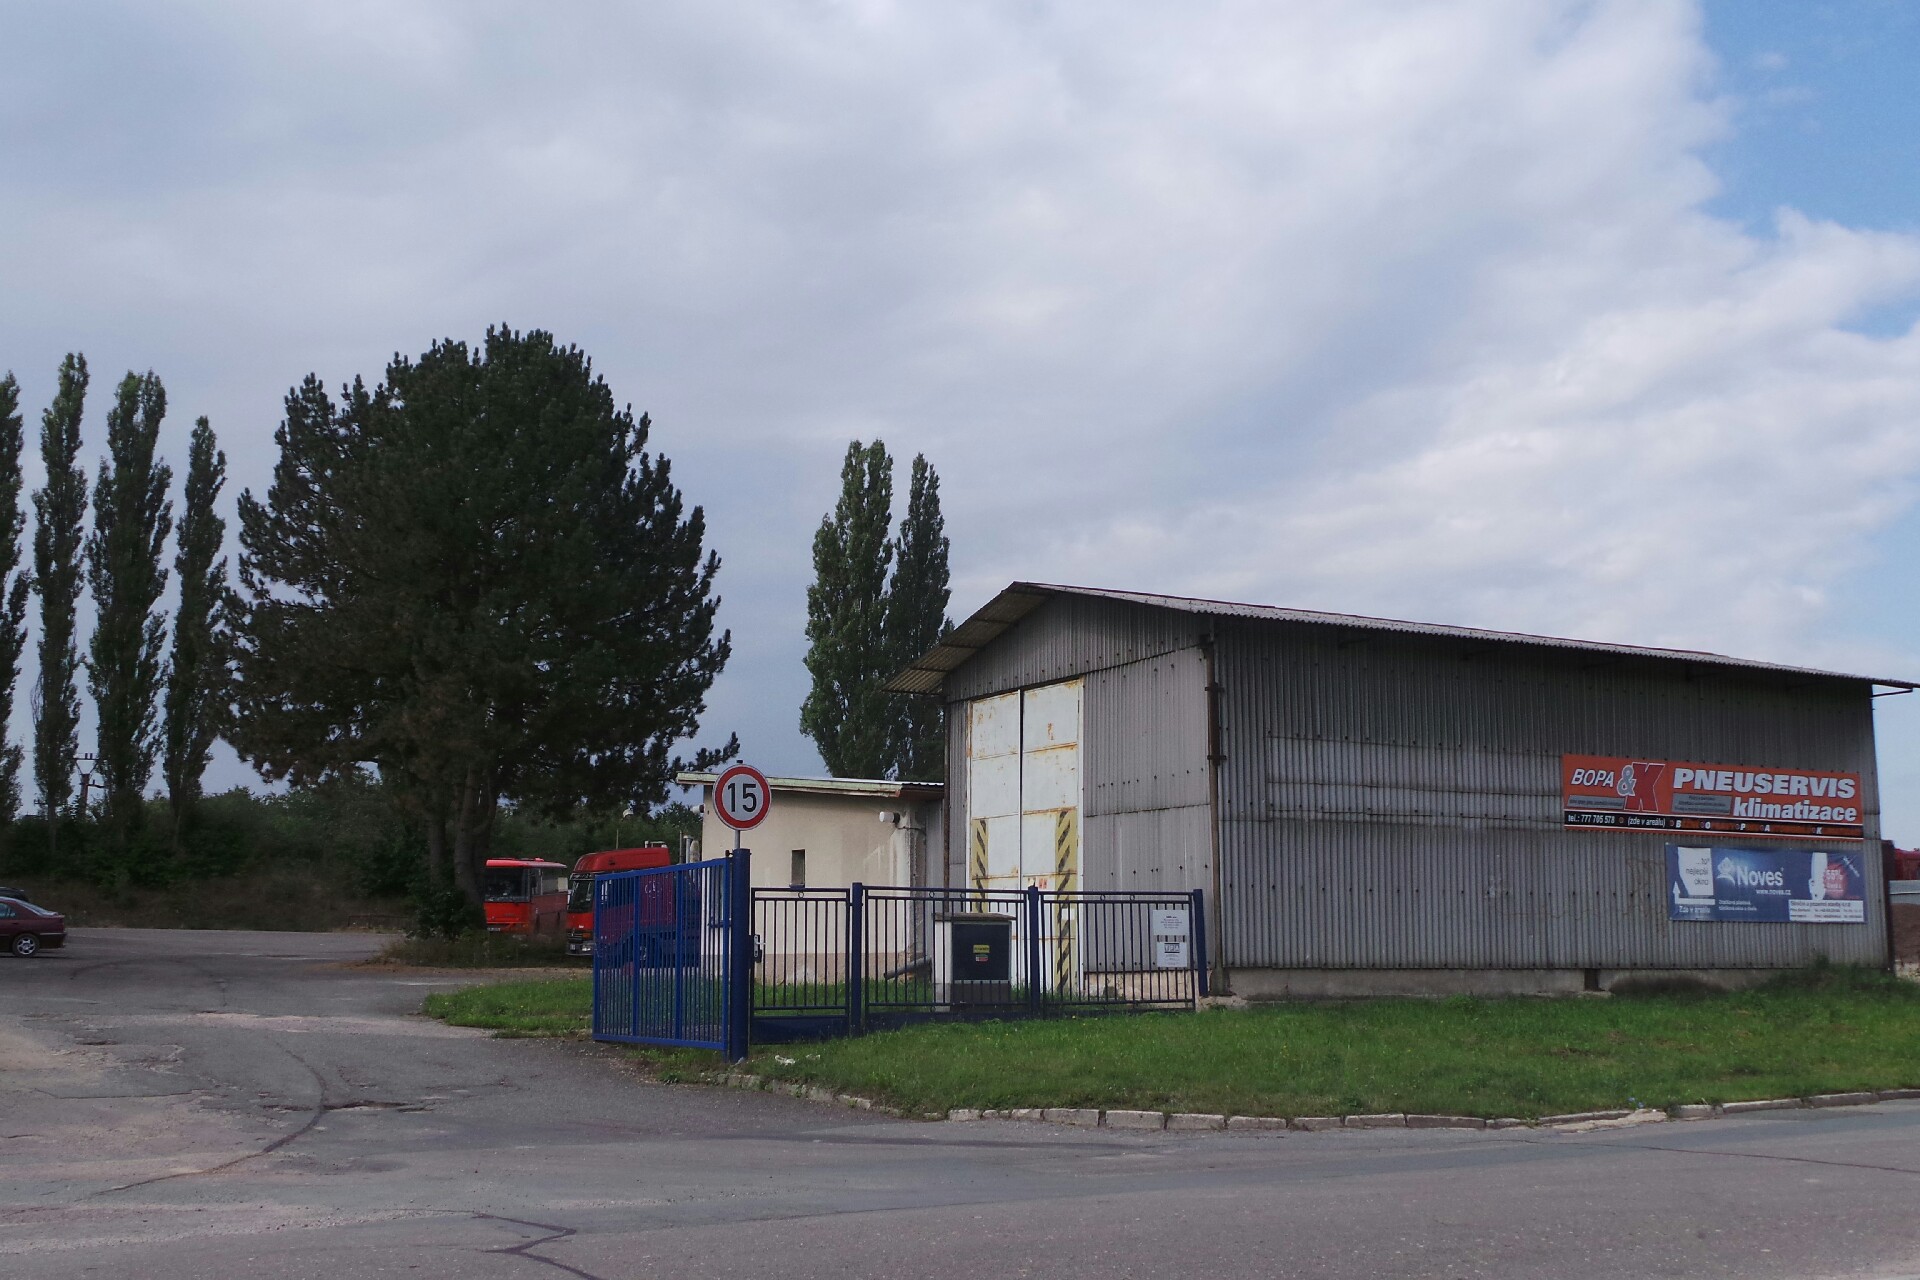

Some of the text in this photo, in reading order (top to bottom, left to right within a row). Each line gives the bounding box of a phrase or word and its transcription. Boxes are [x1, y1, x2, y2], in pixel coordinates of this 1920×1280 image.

[1571, 761, 1666, 813] BOPA & K
[1673, 767, 1856, 799] PNEUSERVIS
[728, 783, 757, 813] 15
[1733, 796, 1857, 822] klimatizace
[1581, 814, 1591, 823] 777
[1604, 815, 1615, 824] 578
[1737, 866, 1784, 886] Noves
